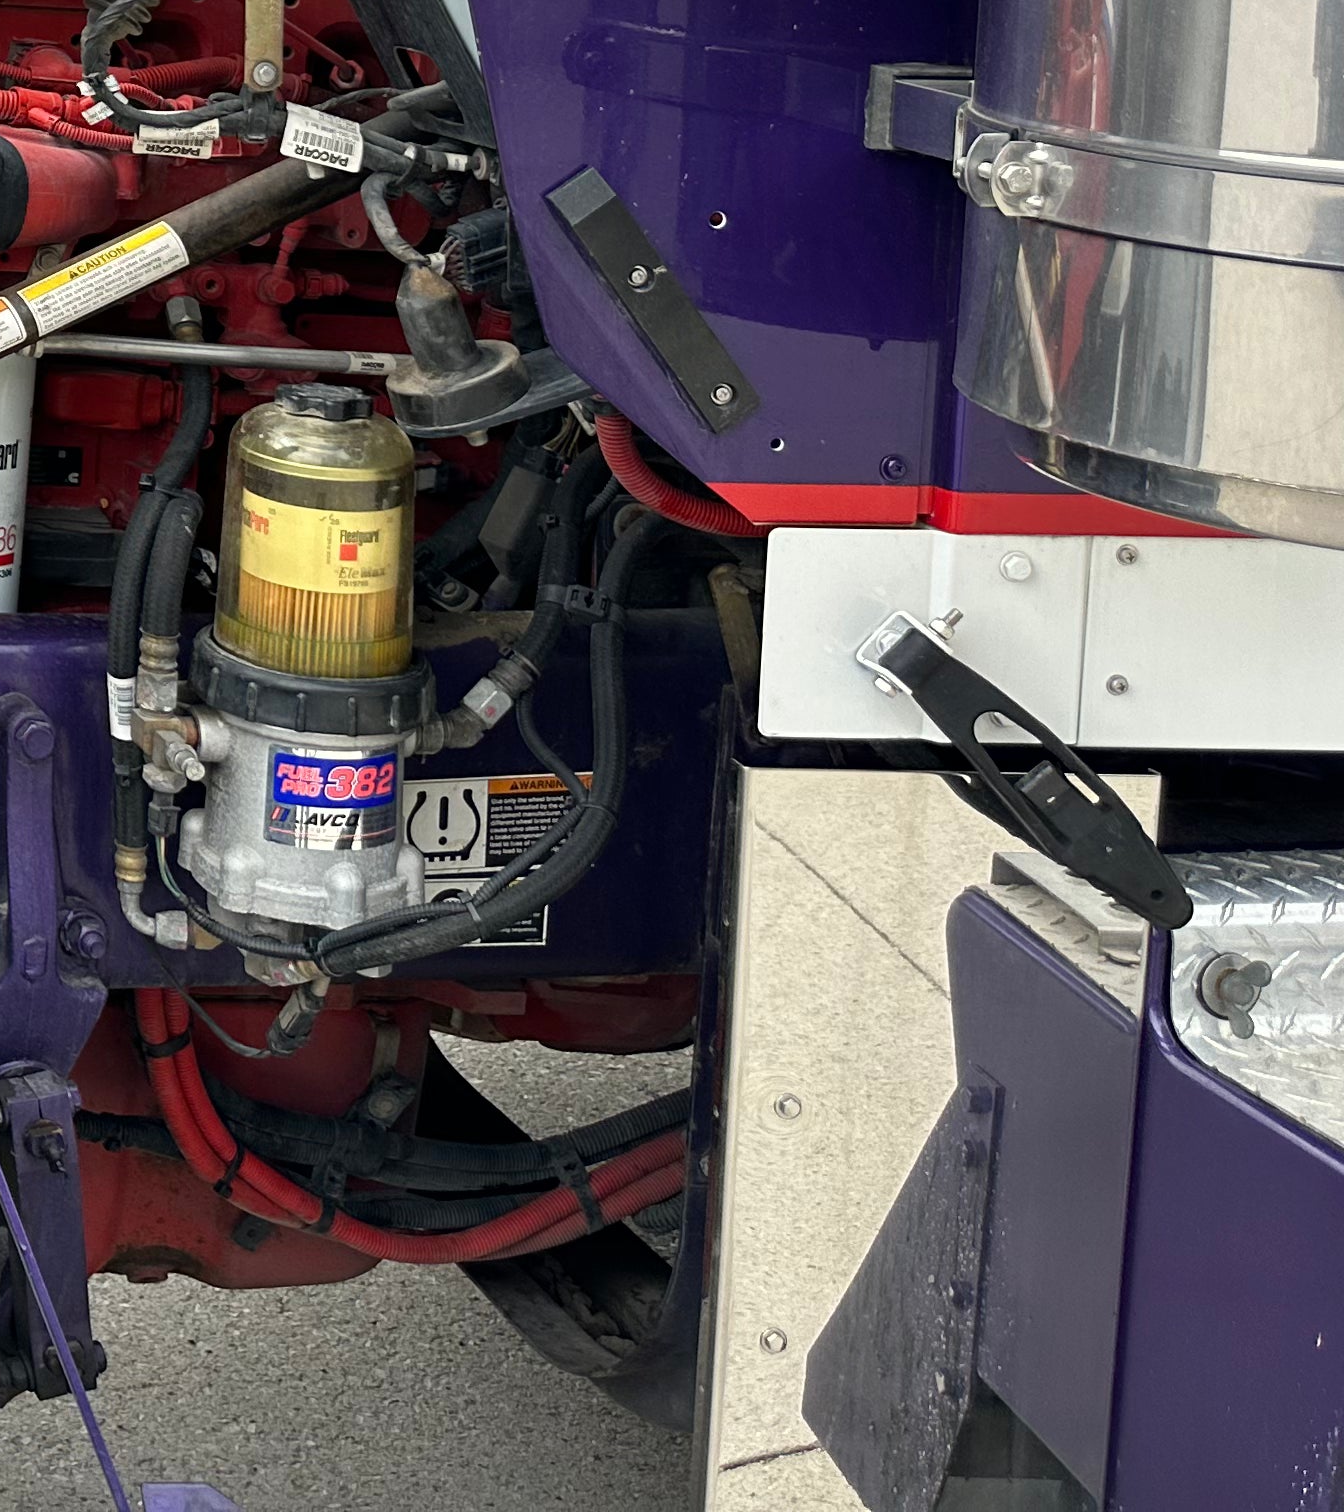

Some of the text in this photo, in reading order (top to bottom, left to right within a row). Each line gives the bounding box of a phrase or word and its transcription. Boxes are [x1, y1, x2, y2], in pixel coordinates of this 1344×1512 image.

[146, 143, 201, 157] PACCAR
[294, 144, 349, 167] PACCAR
[76, 243, 127, 275] CAUTION
[340, 529, 380, 546] Fleetguard
[277, 763, 323, 783] FUEL
[324, 762, 396, 801] 382
[280, 780, 324, 797] PRO
[519, 780, 563, 789] WARNIN
[291, 813, 360, 827] AVCO
